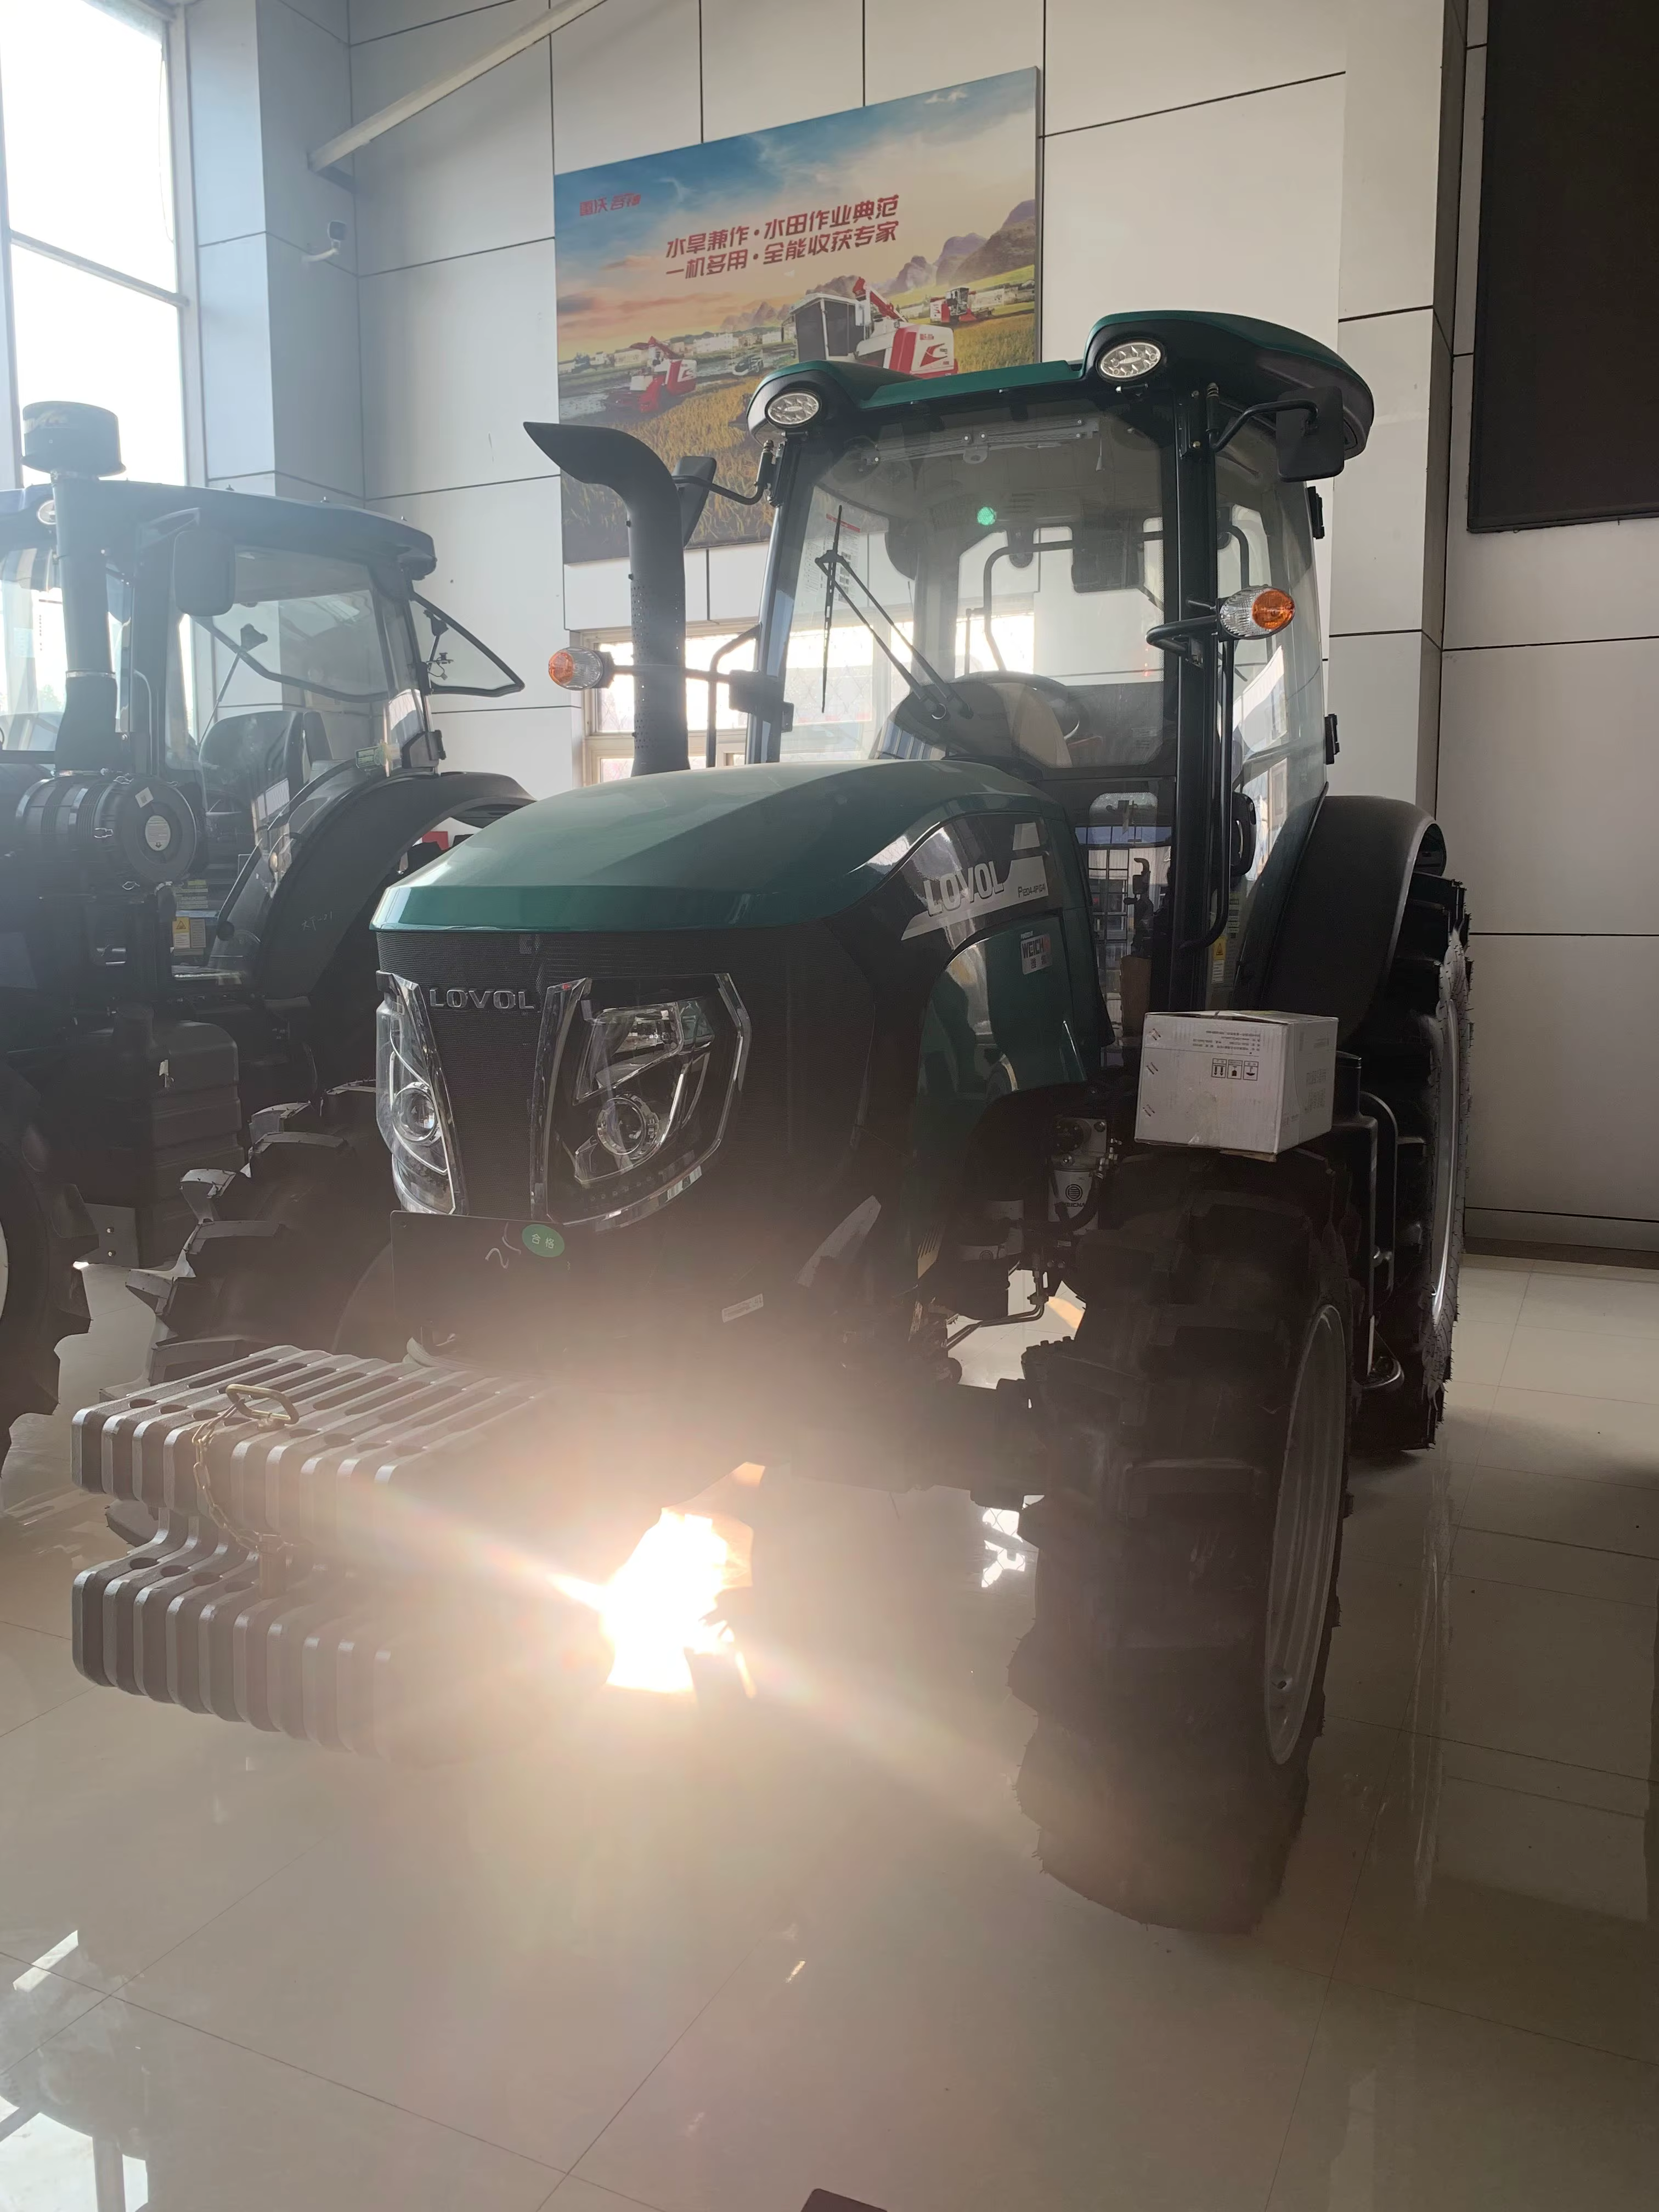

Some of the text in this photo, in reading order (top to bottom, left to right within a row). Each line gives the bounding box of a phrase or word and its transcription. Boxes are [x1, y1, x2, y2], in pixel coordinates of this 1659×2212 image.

[923, 861, 1005, 917] LOVOL
[430, 989, 535, 1009] LOVOL
[532, 1233, 555, 1249] 合格
